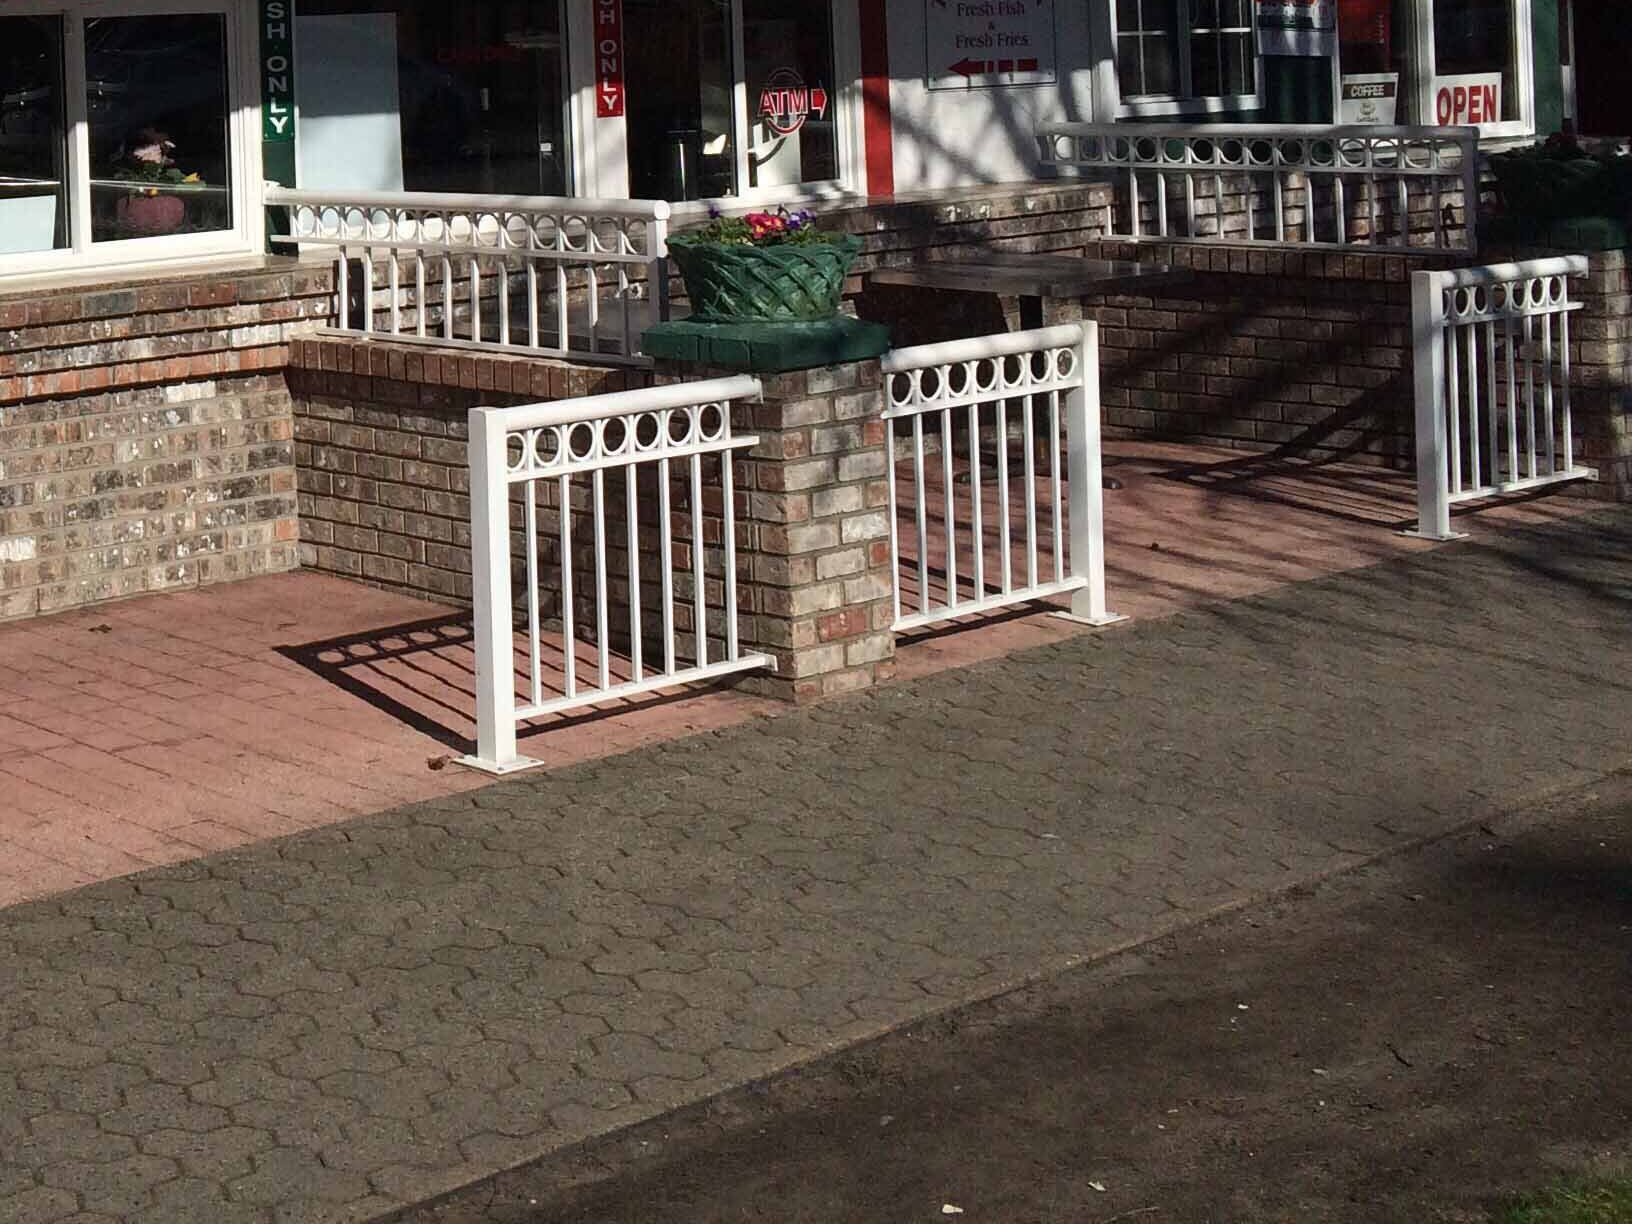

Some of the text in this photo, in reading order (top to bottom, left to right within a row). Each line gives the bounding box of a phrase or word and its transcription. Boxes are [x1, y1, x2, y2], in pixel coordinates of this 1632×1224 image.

[998, 0, 1025, 16] Fish
[266, 55, 290, 135] ONLY
[598, 39, 618, 110] ONLY
[757, 87, 809, 117] ATM
[1435, 83, 1497, 128] OPEN
